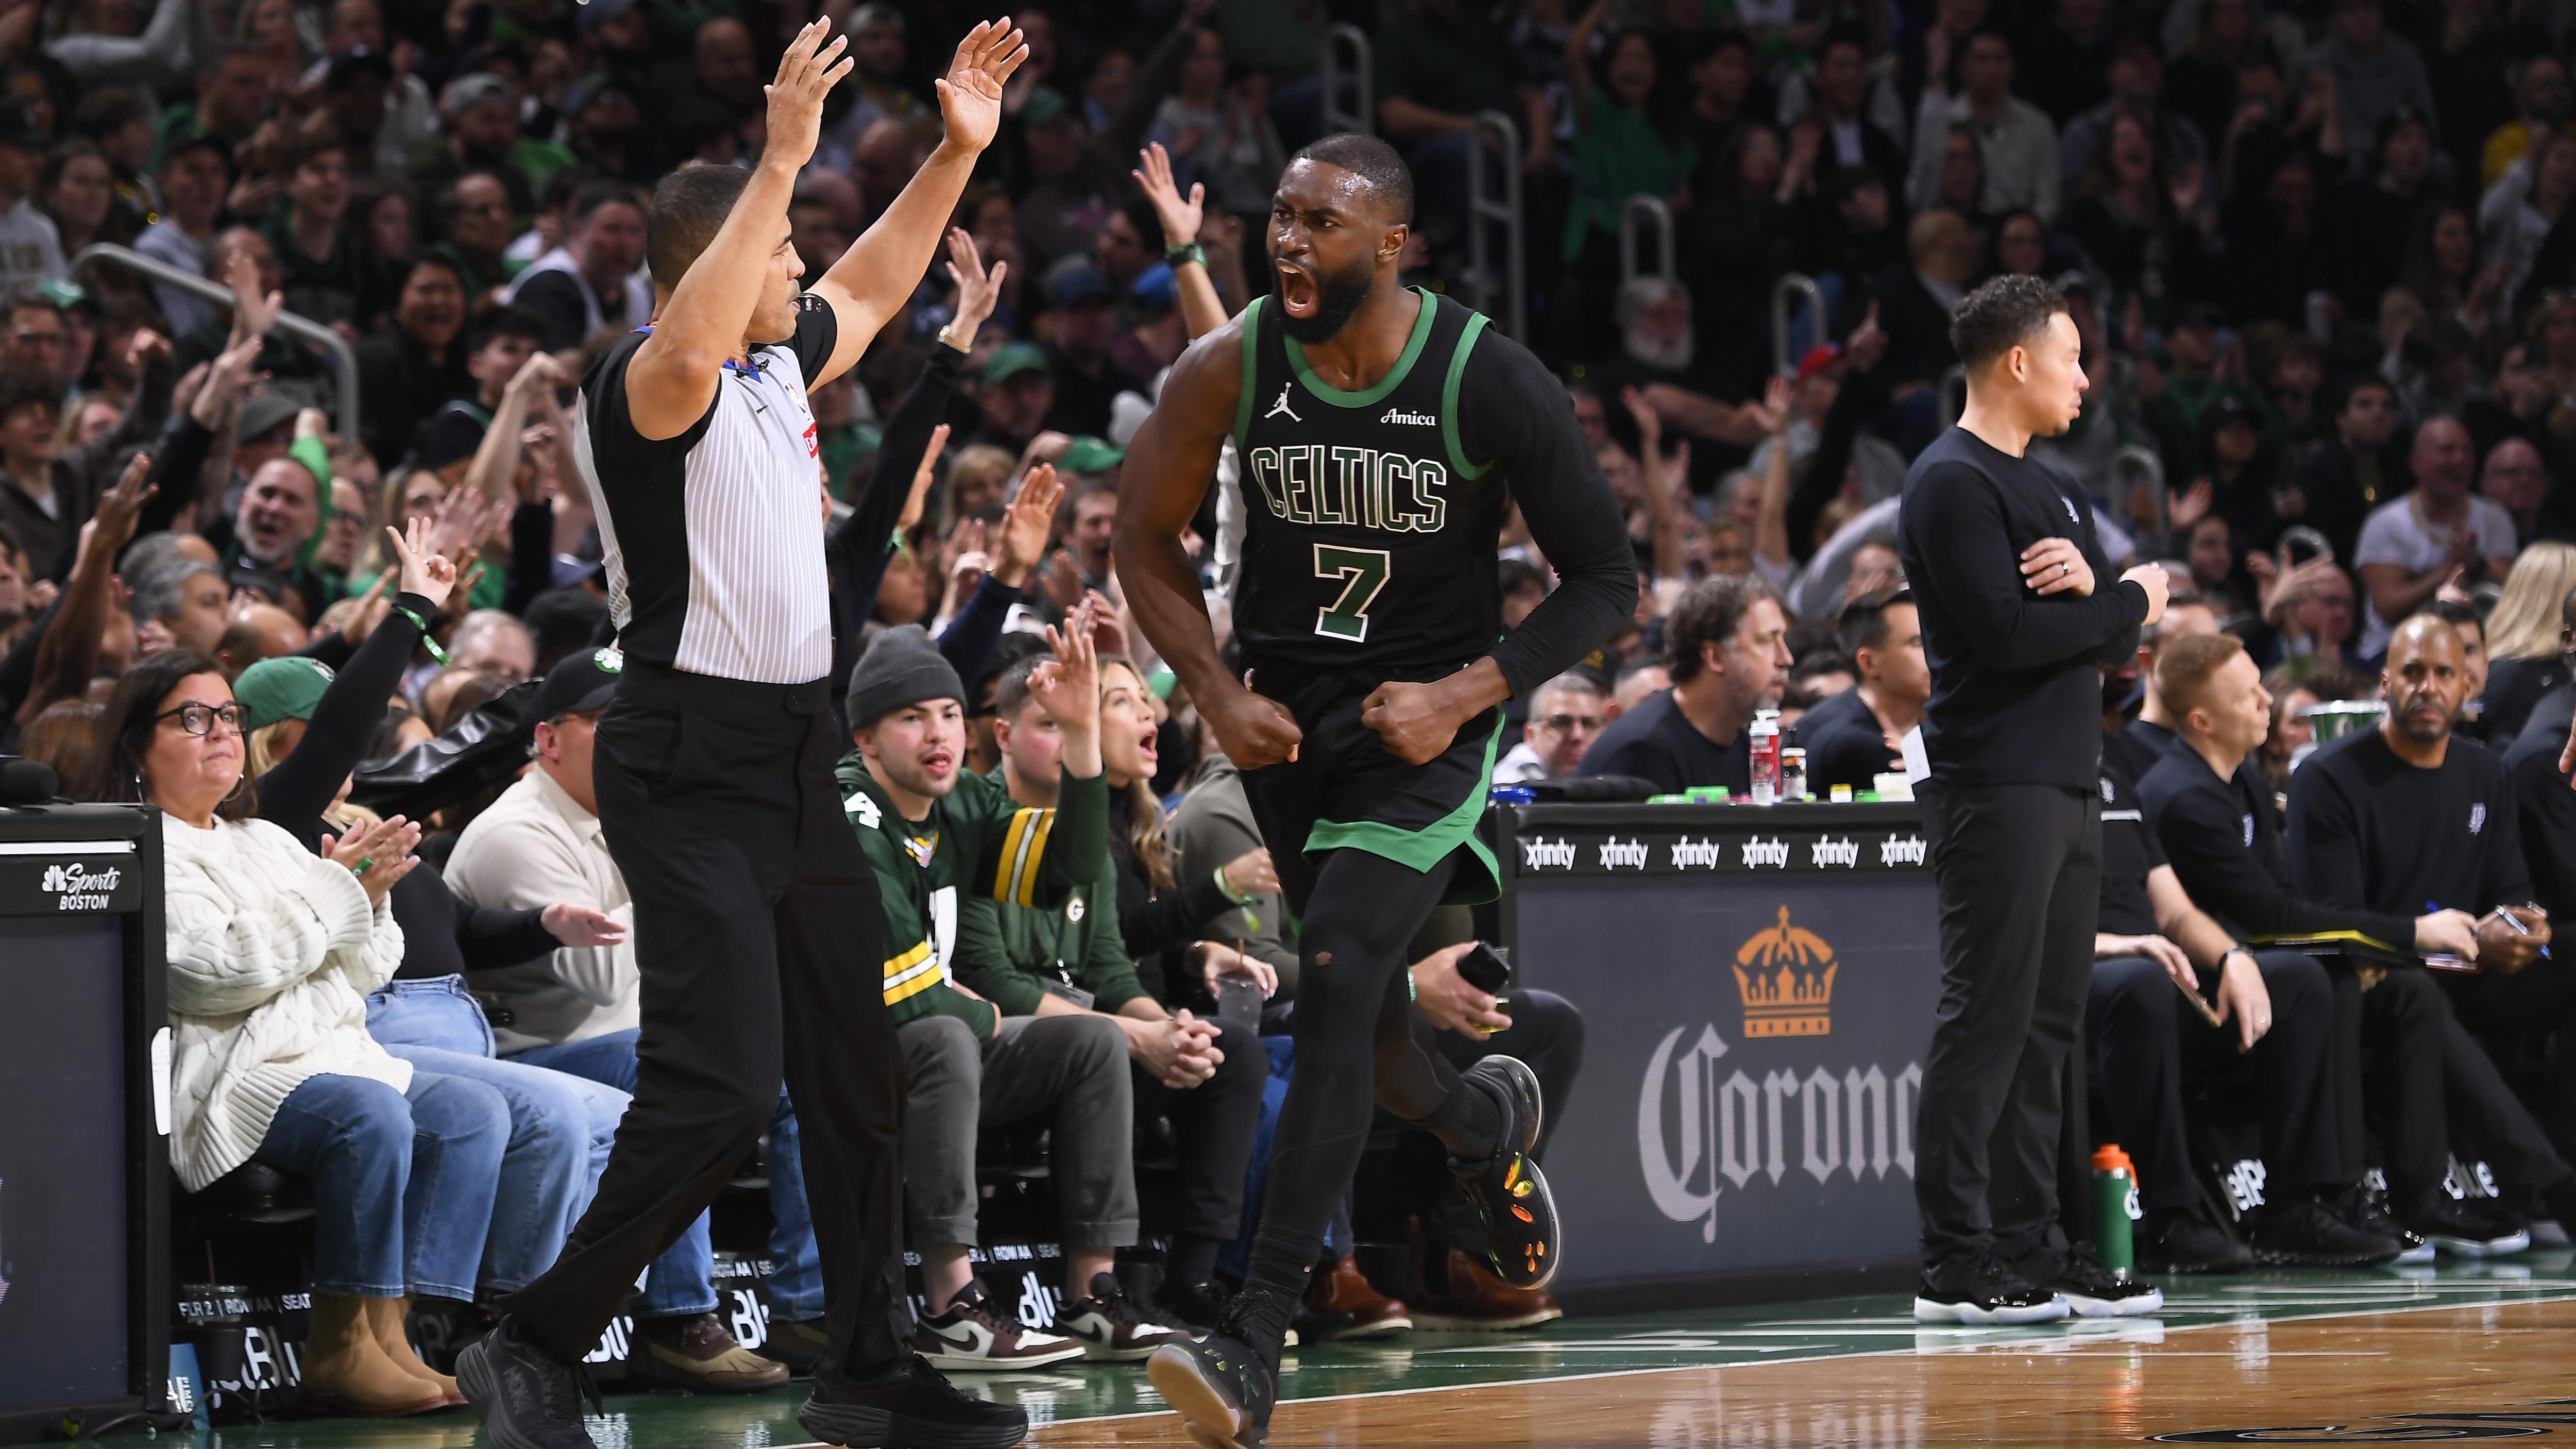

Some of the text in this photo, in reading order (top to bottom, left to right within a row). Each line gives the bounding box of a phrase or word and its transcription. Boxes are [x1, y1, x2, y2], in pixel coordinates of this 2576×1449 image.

[1381, 408, 1436, 426] Amica
[1250, 445, 1446, 532] CELTICS
[1313, 543, 1390, 643] 7
[844, 791, 882, 829] 4
[1524, 832, 1927, 870] xfinity xfinity xfinity xfinity xfinity xfinity
[65, 862, 122, 896] Sports
[58, 895, 110, 911] BOSTON
[178, 1301, 204, 1317] FLR
[204, 1300, 214, 1316] 2
[281, 1292, 312, 1310] SEAT
